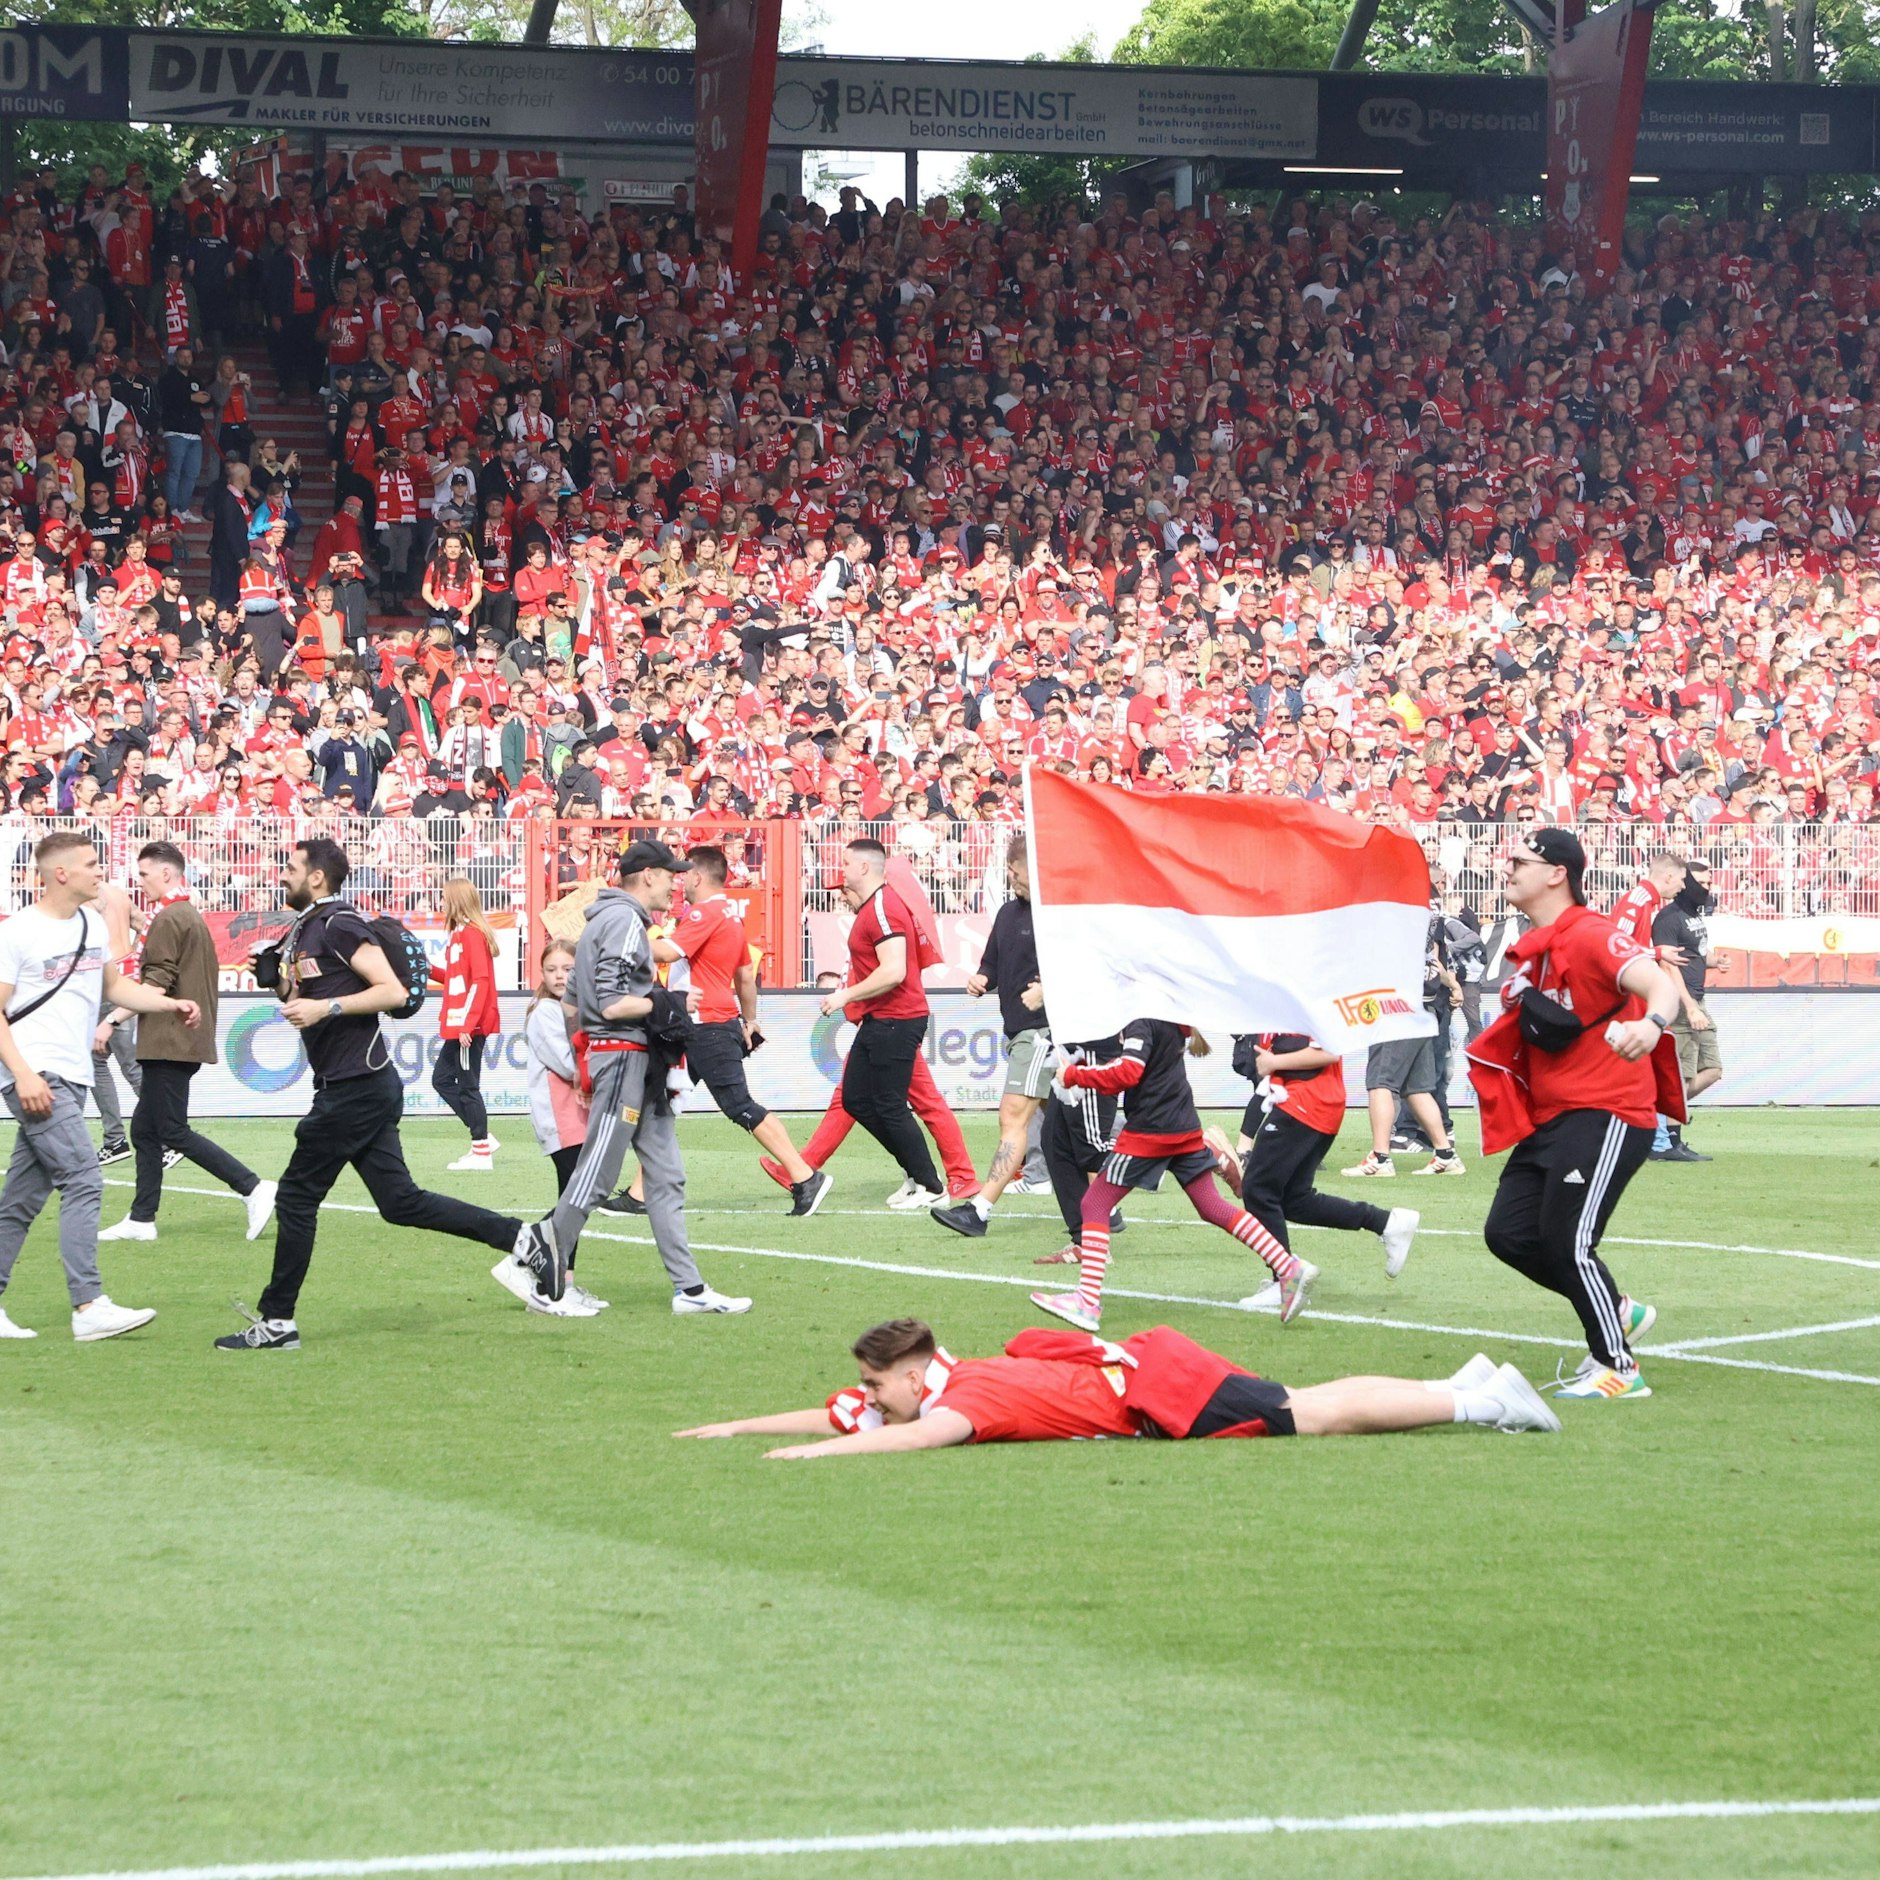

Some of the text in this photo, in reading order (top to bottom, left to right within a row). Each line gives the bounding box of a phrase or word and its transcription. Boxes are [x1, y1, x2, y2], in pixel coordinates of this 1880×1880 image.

[149, 44, 350, 99] DIVAL
[379, 54, 568, 84] Unsere Kompetenz
[623, 66, 649, 83] 54
[655, 67, 681, 85] 00
[411, 83, 449, 102] Ihre
[457, 86, 555, 109] Sicherheit
[846, 80, 1107, 123] BÄRENDIENST GmbH
[1138, 88, 1236, 102] Kernbohrungen
[256, 107, 490, 128] MAKLER FÜR VERSICHERUNGEN
[1138, 104, 1258, 117] Betonsägearbeiten
[1368, 106, 1413, 129] WS
[1428, 108, 1541, 132] Personal
[1650, 110, 1785, 125] Bereich Handwerk:
[910, 120, 1107, 142] betonschneidearbeiten
[1138, 117, 1282, 132] Bewehrungsanschlüsse
[1137, 134, 1168, 145] mail:
